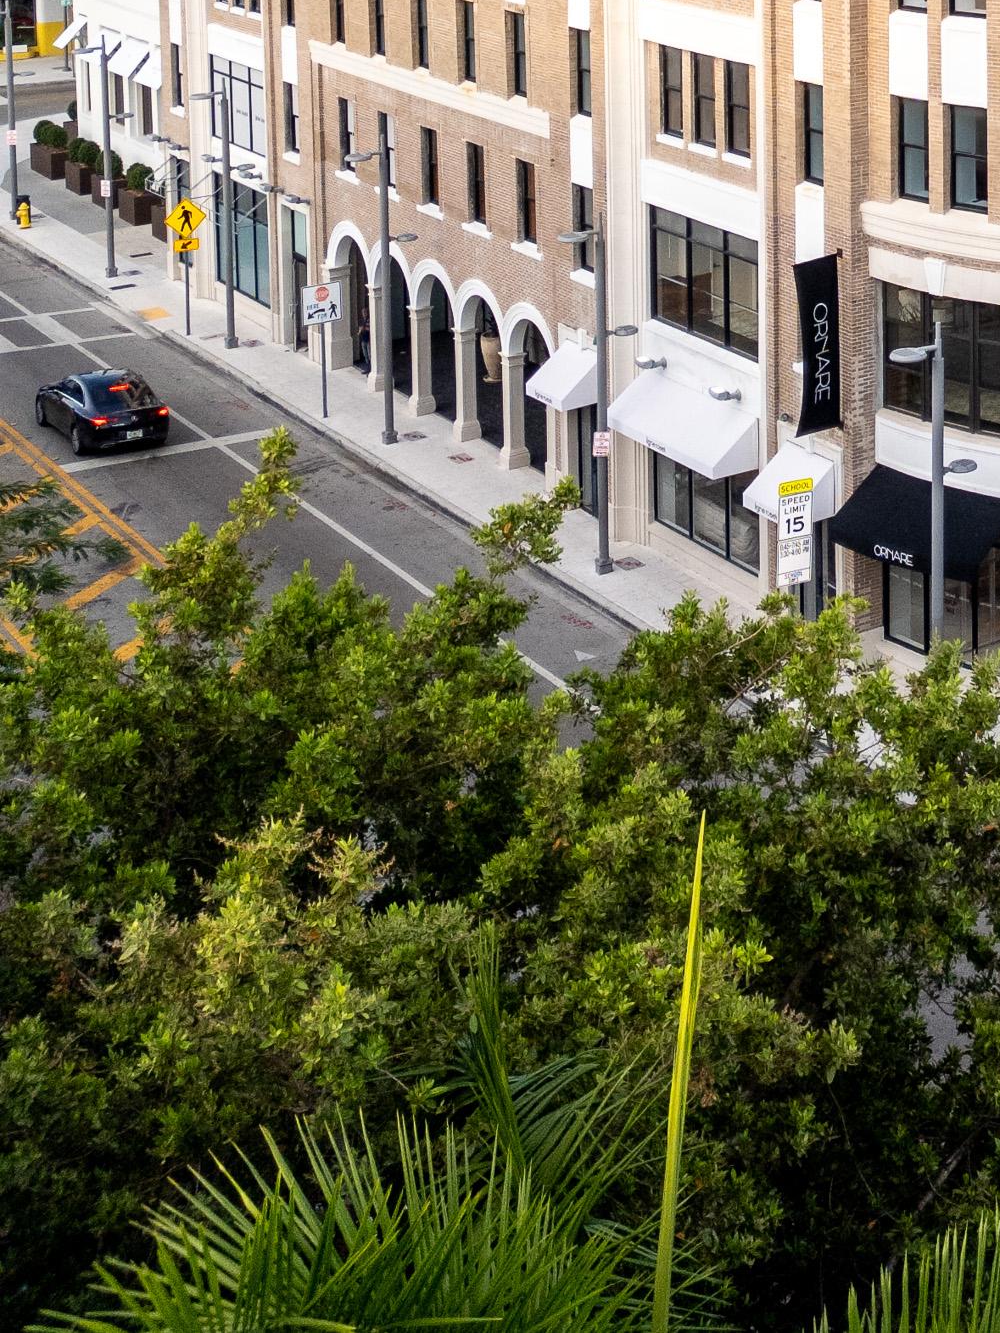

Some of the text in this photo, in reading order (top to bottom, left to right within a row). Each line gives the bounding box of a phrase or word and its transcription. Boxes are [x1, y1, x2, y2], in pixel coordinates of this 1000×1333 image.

[812, 302, 831, 404] ORNARE
[781, 481, 810, 493] SCHOOL
[781, 495, 810, 506] SPEED
[784, 504, 806, 515] LIMIT
[785, 515, 805, 534] 15
[873, 544, 914, 567] ORNARE
